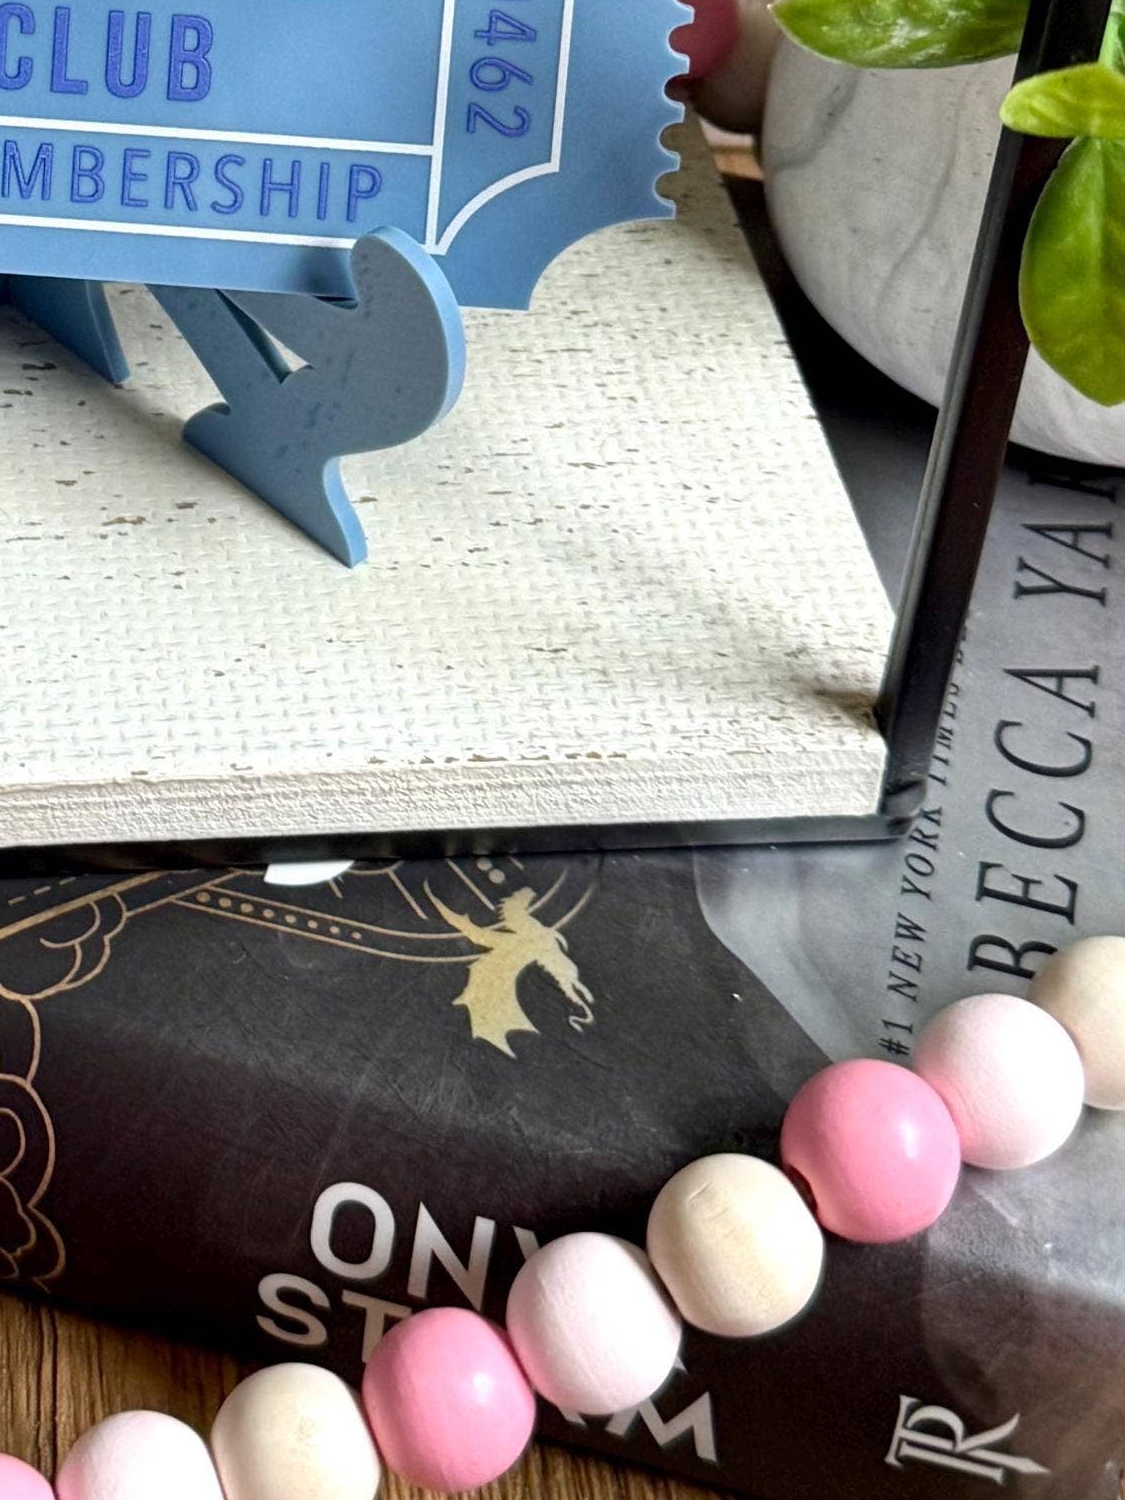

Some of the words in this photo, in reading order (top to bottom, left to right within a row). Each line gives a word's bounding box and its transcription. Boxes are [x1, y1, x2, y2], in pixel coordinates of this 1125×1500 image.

[900, 806, 943, 900] YORK
[887, 911, 928, 1003] NEW
[878, 1017, 913, 1056] #1
